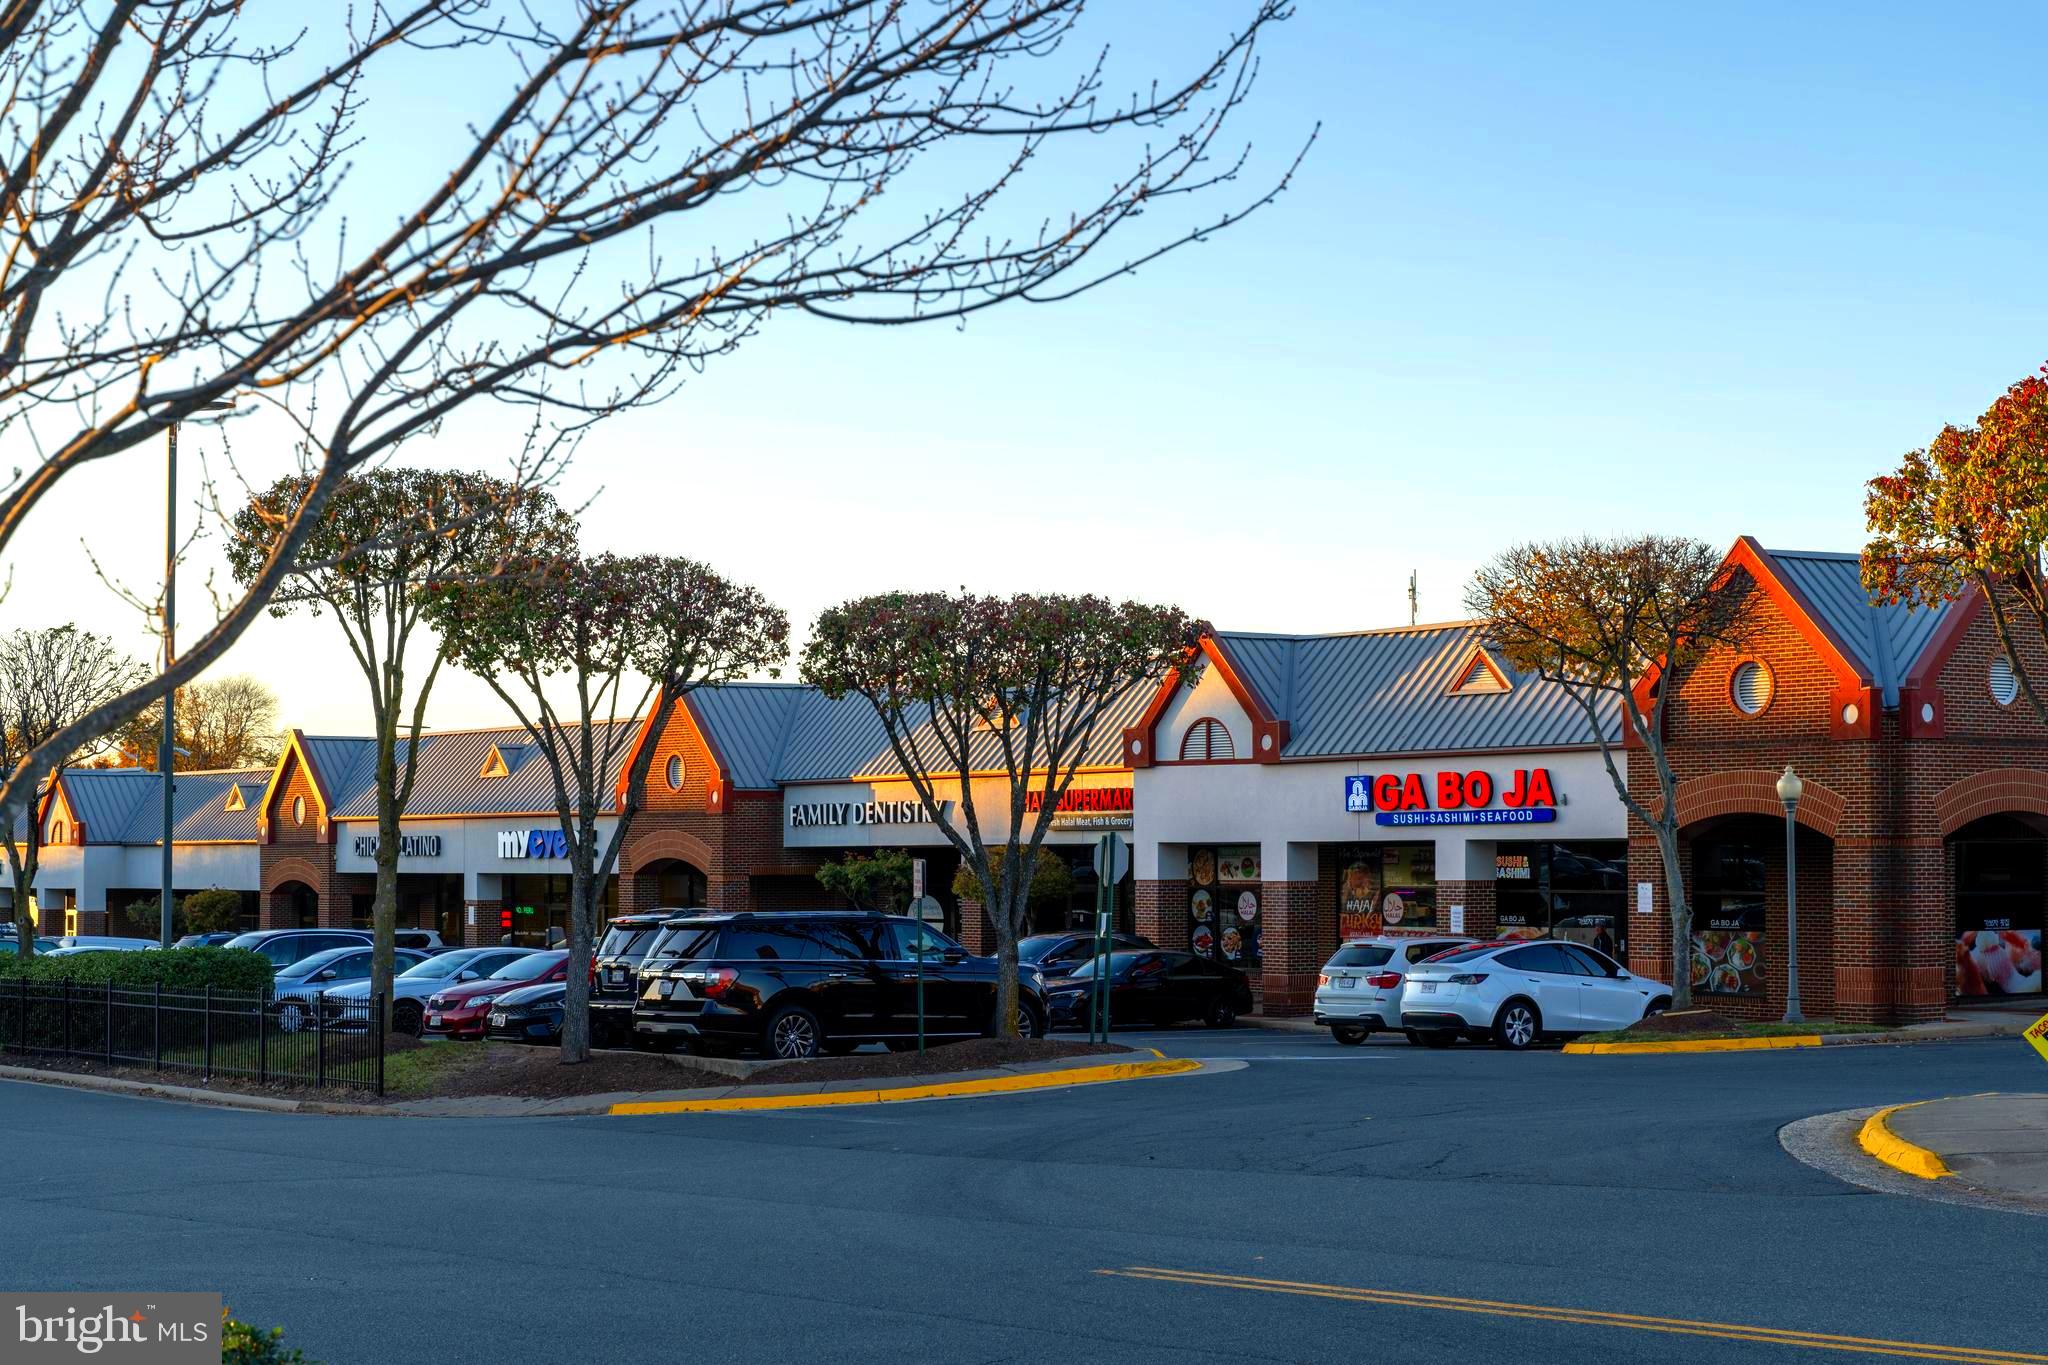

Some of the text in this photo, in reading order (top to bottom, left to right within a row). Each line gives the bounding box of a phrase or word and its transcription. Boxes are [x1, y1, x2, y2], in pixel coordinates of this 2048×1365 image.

[1374, 768, 1558, 811] GA BO JA
[789, 800, 944, 827] FAMILY DENTISTRY
[1093, 817, 1104, 826] Fish
[1105, 817, 1110, 826] &
[1111, 816, 1132, 828] Grocery
